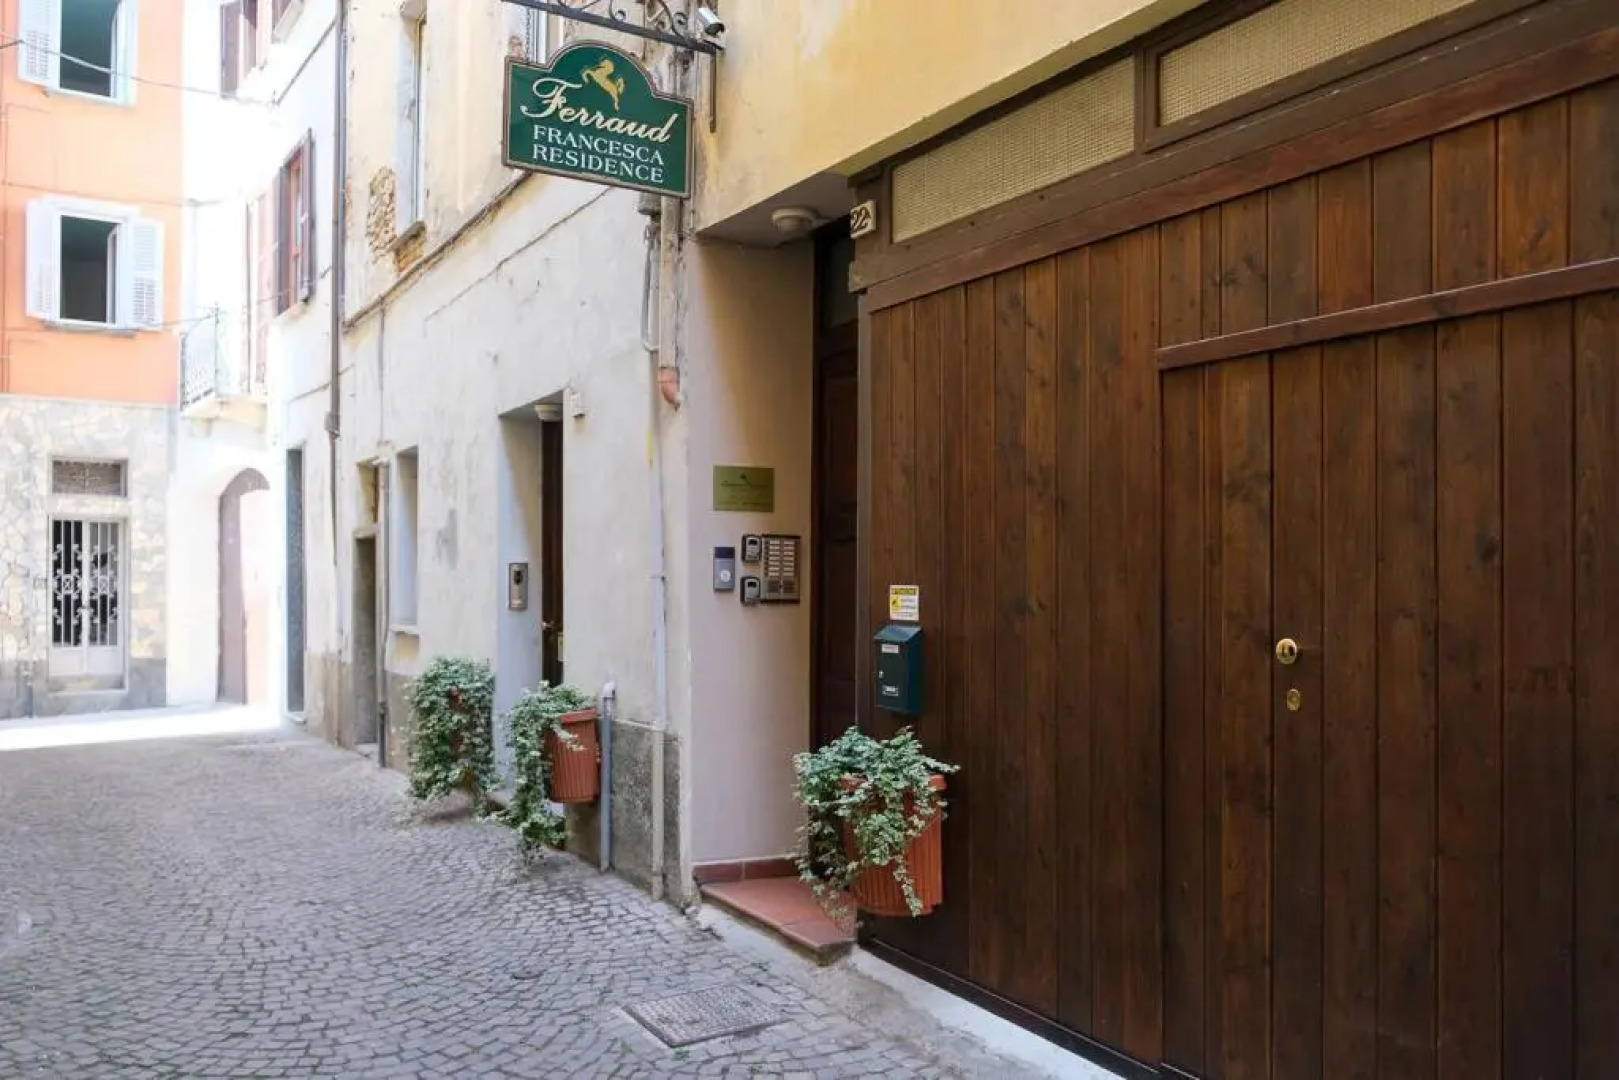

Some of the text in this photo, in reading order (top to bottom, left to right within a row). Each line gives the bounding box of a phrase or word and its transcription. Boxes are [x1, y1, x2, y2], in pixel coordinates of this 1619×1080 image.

[519, 77, 679, 144] Ferraud
[533, 125, 665, 166] FRANCESCA
[533, 144, 664, 184] RESIDENCE
